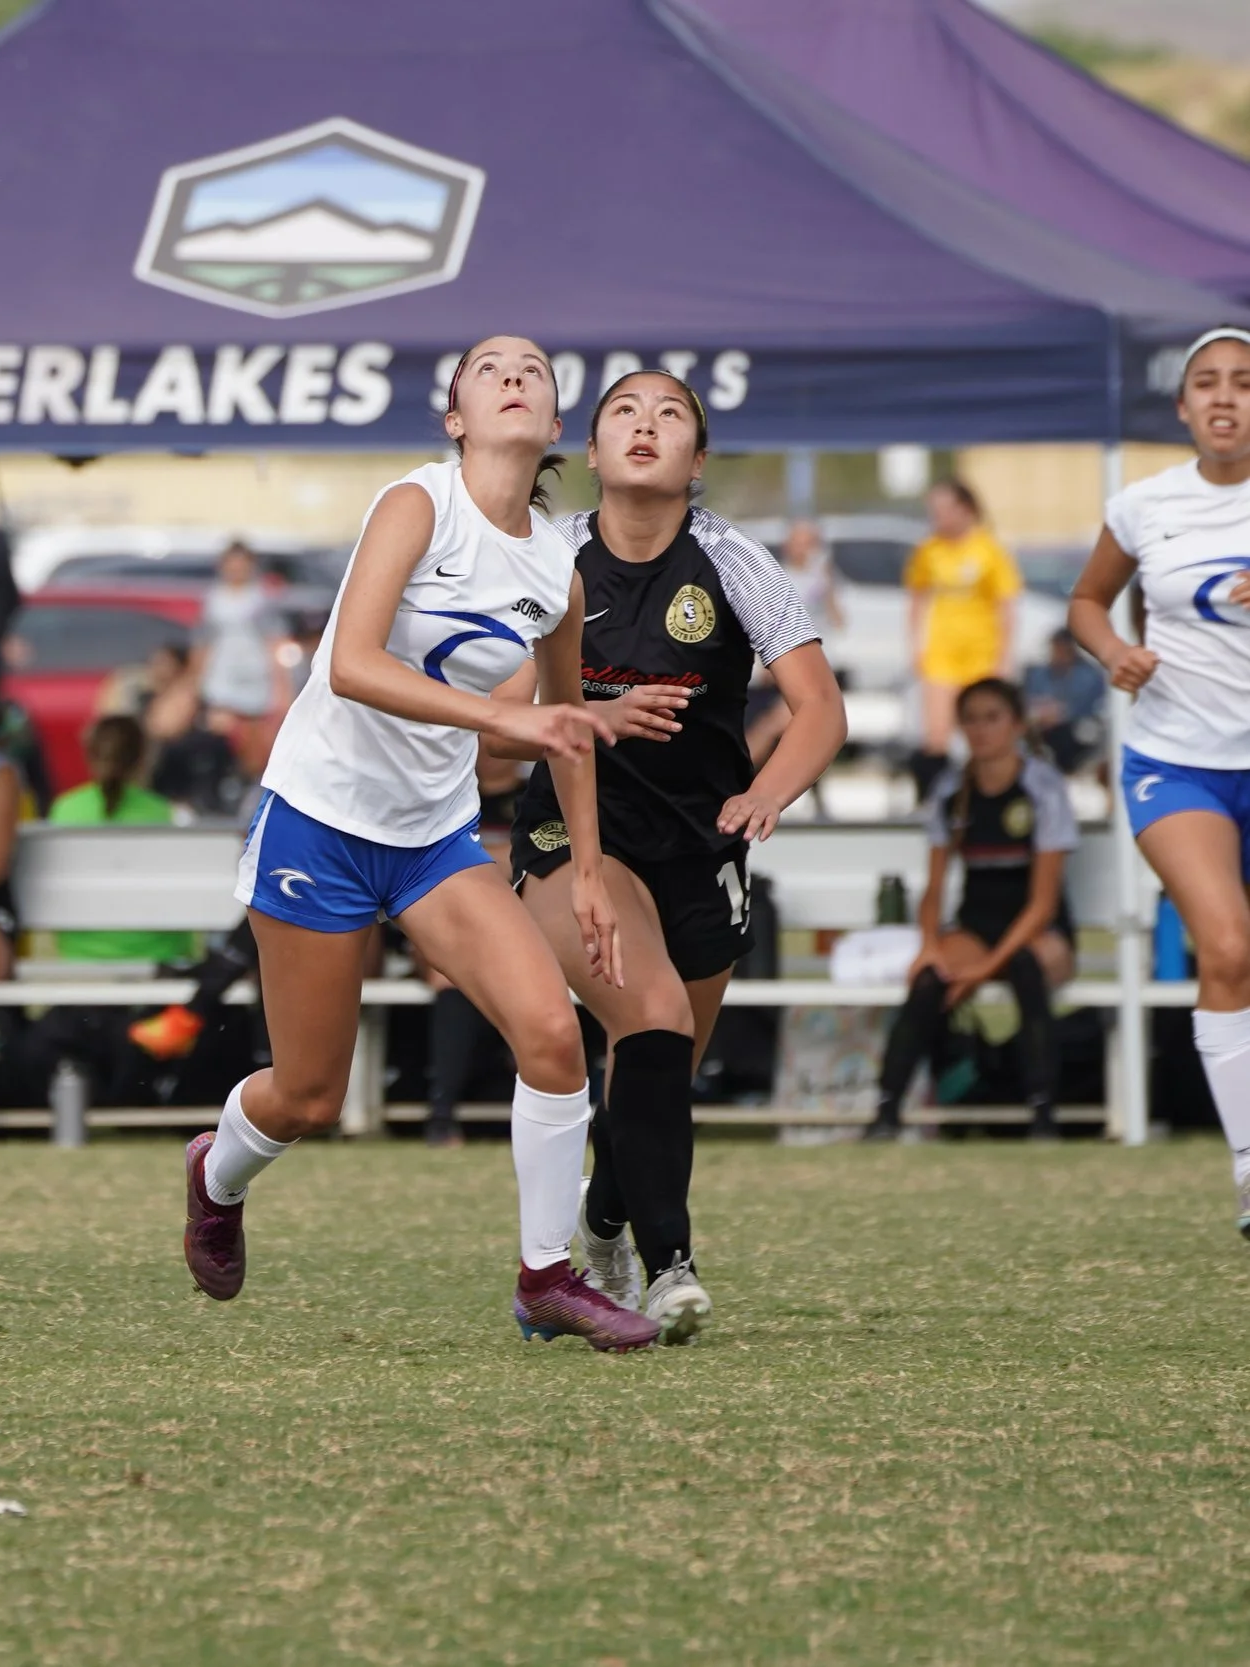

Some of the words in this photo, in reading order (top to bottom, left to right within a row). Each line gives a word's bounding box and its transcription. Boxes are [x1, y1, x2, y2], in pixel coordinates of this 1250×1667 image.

[429, 350, 751, 411] SORTS
[510, 597, 549, 622] SURF
[668, 621, 703, 641] FOOTBALL
[701, 616, 714, 636] CLUB
[581, 657, 703, 687] alifornia
[716, 861, 751, 935] 1
